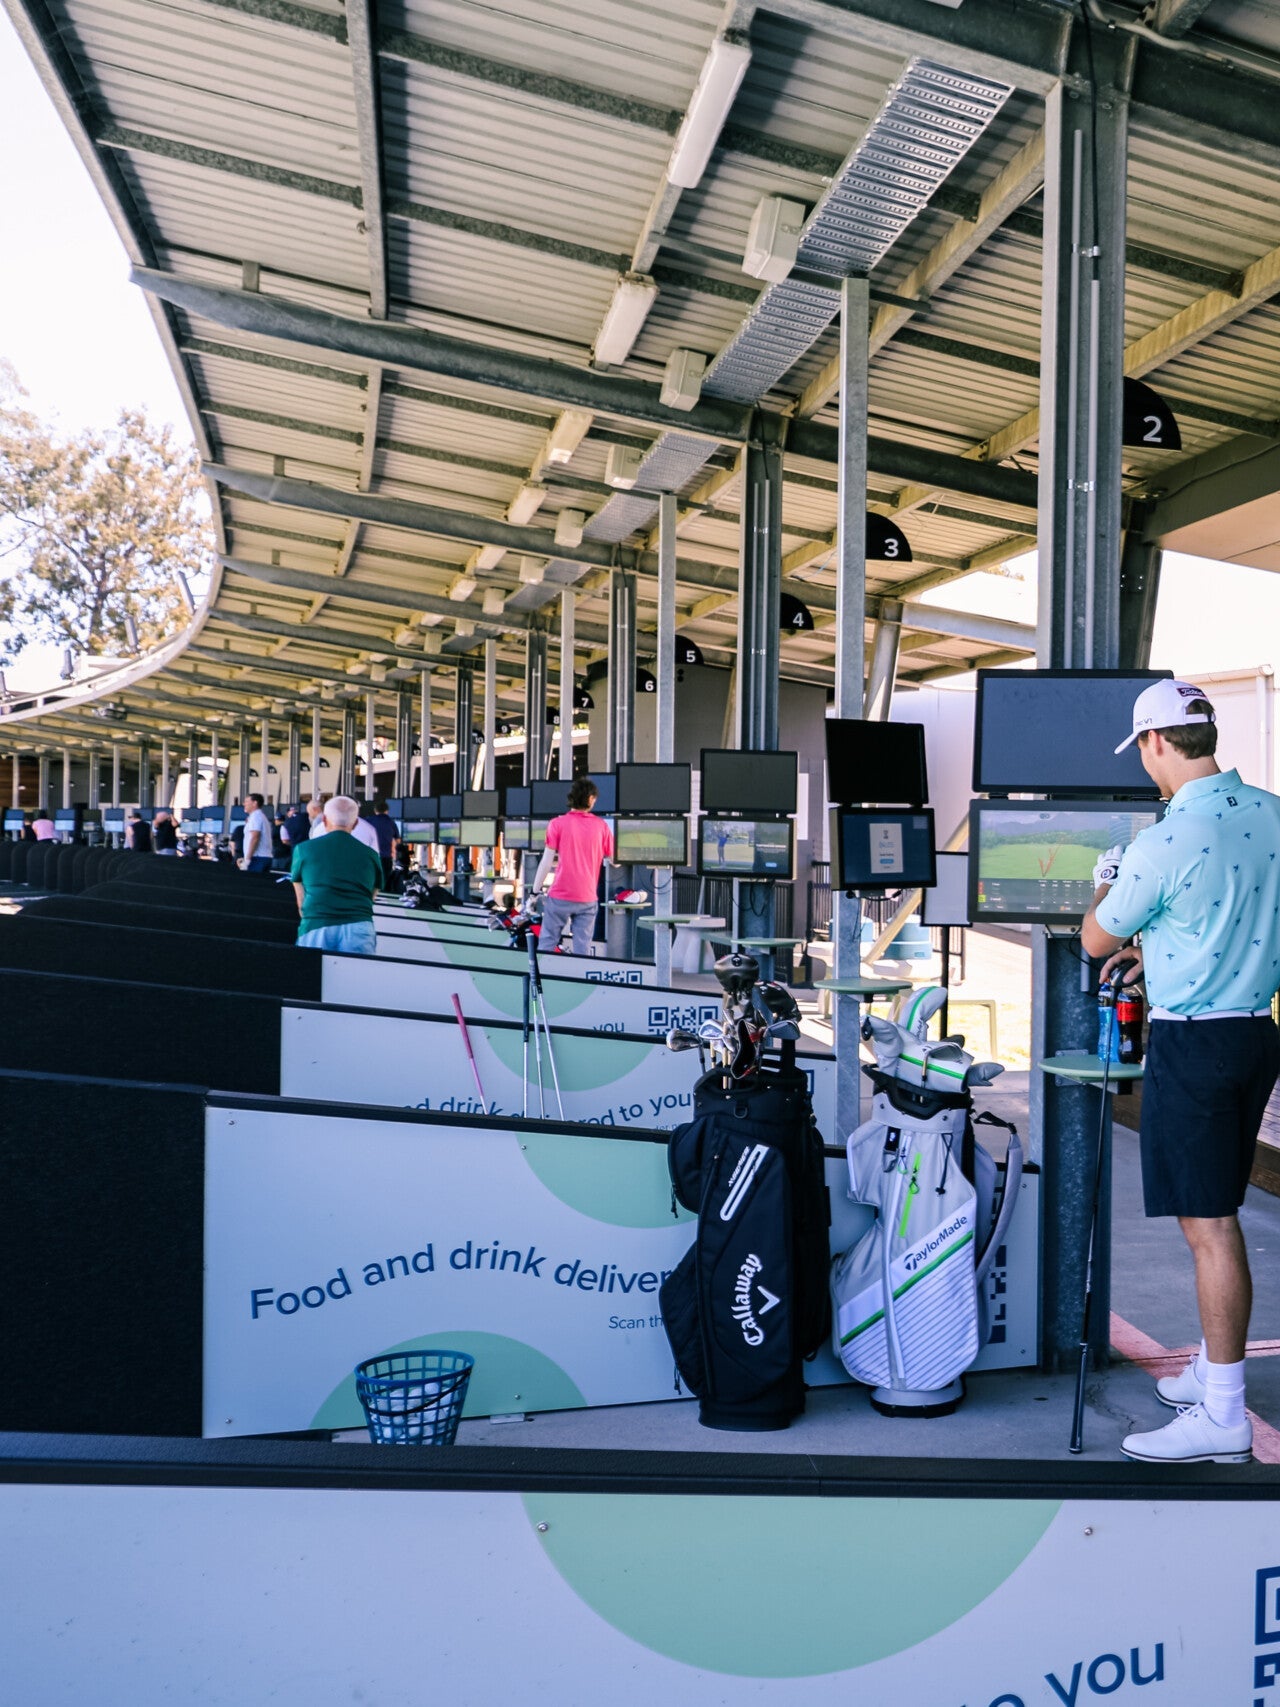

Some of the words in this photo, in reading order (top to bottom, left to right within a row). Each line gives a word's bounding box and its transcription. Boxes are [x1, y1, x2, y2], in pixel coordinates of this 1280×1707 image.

[1143, 415, 1162, 443] 2
[884, 538, 899, 558] 3
[792, 612, 804, 627] 4
[686, 650, 696, 663] 5
[645, 680, 654, 692] 6
[581, 698, 589, 707] 7
[553, 716, 560, 724] 8
[501, 725, 508, 733] 9
[619, 1103, 643, 1122] to
[649, 1092, 691, 1116] you
[902, 1215, 968, 1271] TaylorMade
[249, 1268, 352, 1319] Food
[363, 1243, 435, 1287] and
[449, 1240, 547, 1279] drink
[553, 1257, 671, 1294] deliver
[730, 1253, 764, 1346] Callaway
[608, 1315, 645, 1329] Scan
[649, 1314, 664, 1328] th
[1043, 1642, 1164, 1707] you
